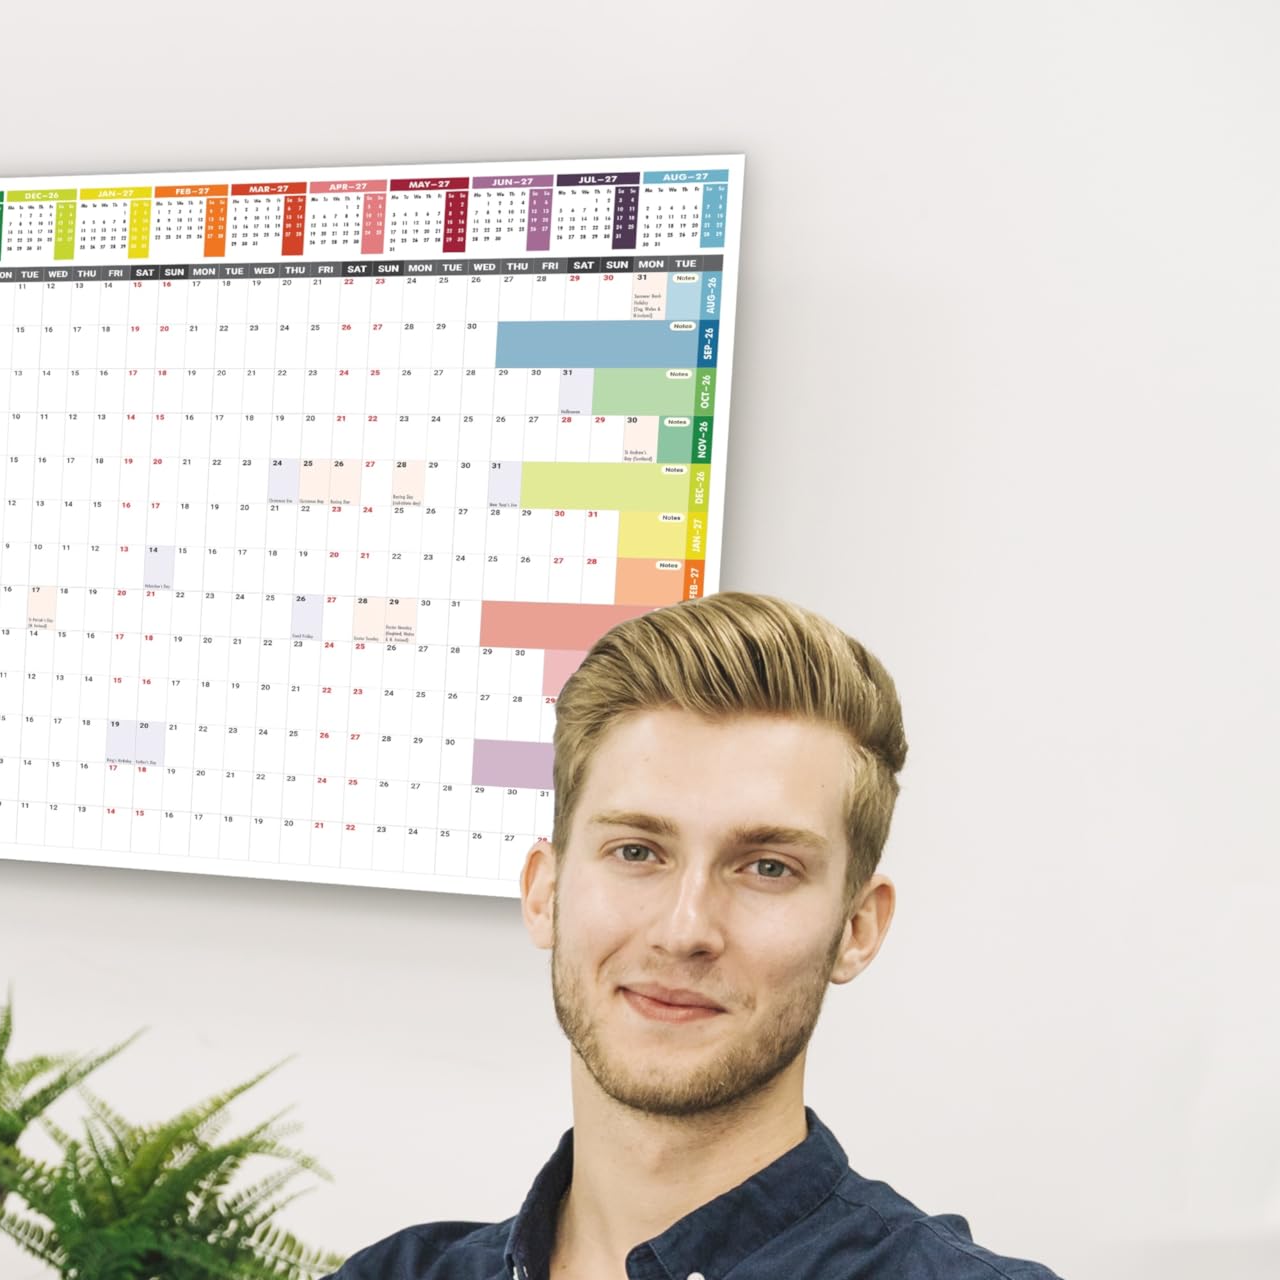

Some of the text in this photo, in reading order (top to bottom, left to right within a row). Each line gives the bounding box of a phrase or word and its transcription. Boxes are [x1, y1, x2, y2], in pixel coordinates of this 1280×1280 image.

[578, 175, 618, 184] JUL-27
[663, 173, 708, 181] AUG-27
[409, 180, 451, 188] MAY-27
[492, 178, 534, 186] JUN-27
[175, 187, 210, 195] FEB-27
[249, 185, 289, 193] MAR-27
[24, 192, 59, 200] DEC-26
[20, 270, 39, 279] TUE
[48, 270, 69, 279] WED
[77, 269, 97, 278] THU
[108, 269, 123, 277] FRI
[135, 269, 154, 277] SAT
[164, 268, 185, 277] SUN
[192, 267, 216, 276] MON
[225, 267, 244, 276] TUE
[253, 266, 276, 275] WED
[284, 266, 306, 275] THU
[318, 265, 334, 274] FRI
[347, 265, 367, 274] SAT
[378, 264, 400, 273] SUN
[408, 263, 433, 273] MON
[442, 263, 463, 272] TUE
[473, 263, 496, 272] WED
[506, 262, 529, 271] THU
[541, 261, 559, 270] FRI
[573, 261, 595, 270] SAT
[606, 260, 629, 269] SUN
[638, 259, 665, 269] MON
[675, 259, 697, 268] TUE
[706, 277, 717, 314] AUG-26
[703, 328, 714, 360] SEP-26
[700, 375, 711, 408] OCT-26
[627, 416, 638, 424] 30
[697, 421, 708, 458] NOV-26
[695, 471, 705, 504] DEC-26
[692, 519, 703, 552] JAN-27
[324, 641, 335, 649] 24
[512, 695, 523, 703] 28
[445, 738, 456, 746] 30
